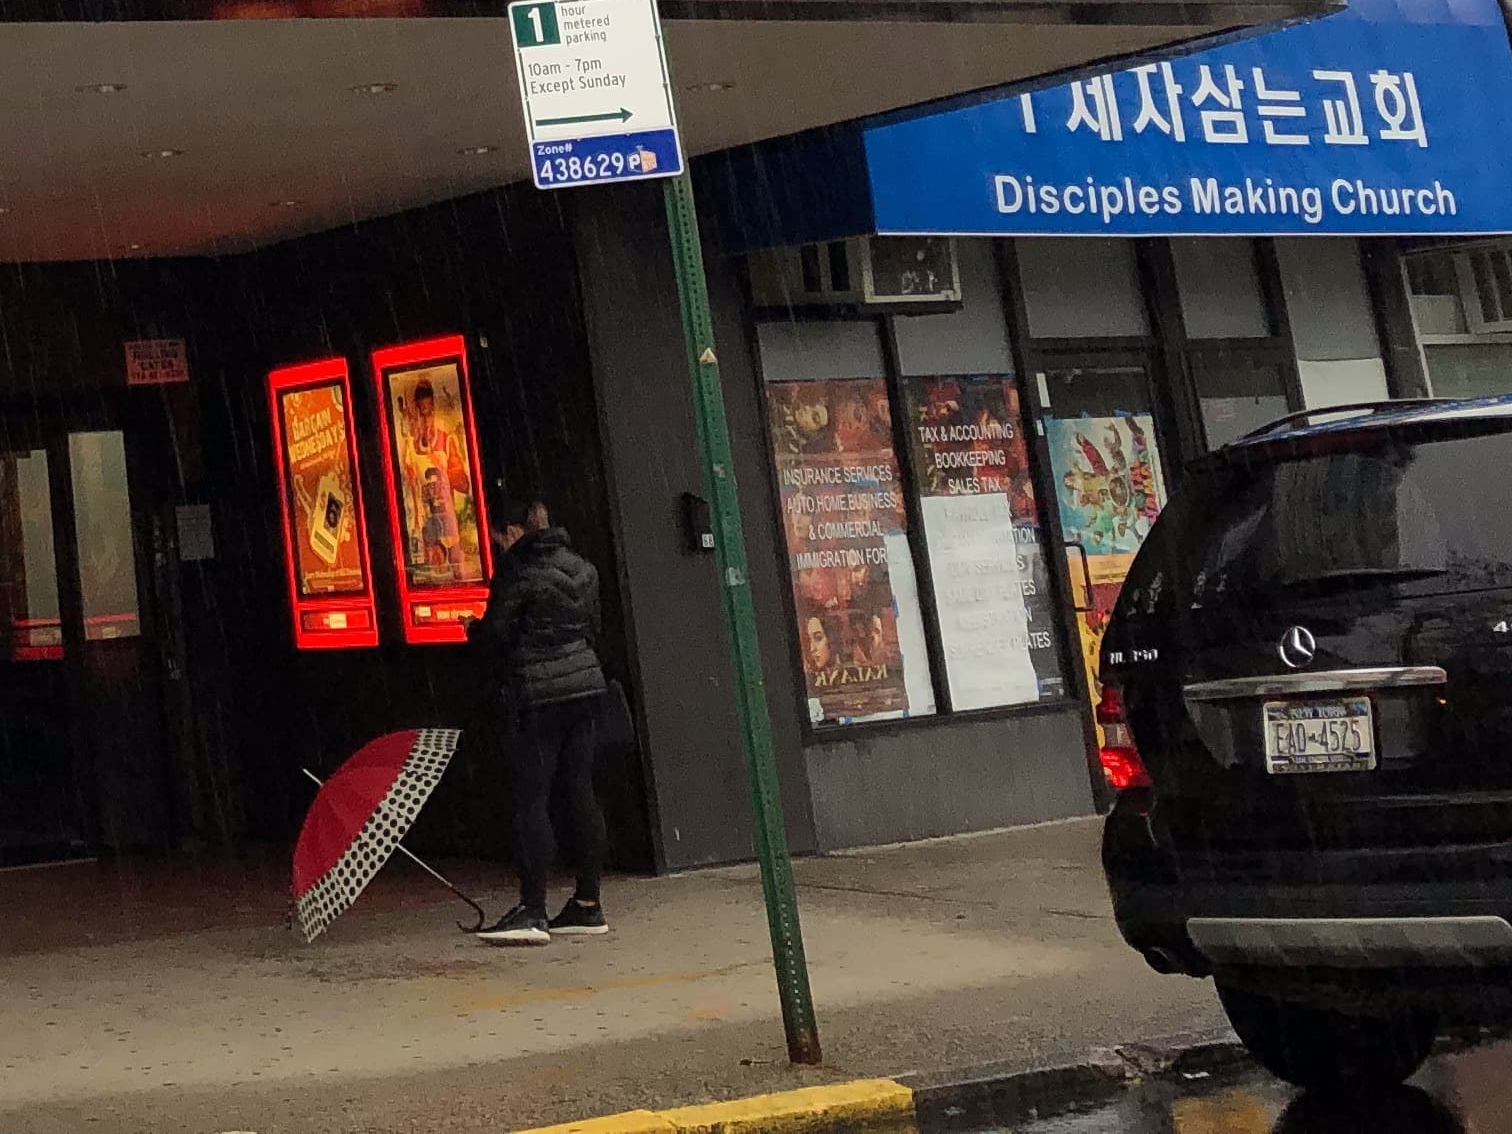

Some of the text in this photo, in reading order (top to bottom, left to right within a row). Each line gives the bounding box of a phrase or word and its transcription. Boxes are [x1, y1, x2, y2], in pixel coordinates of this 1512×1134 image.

[561, 5, 586, 17] hour
[527, 6, 545, 44] 1
[563, 15, 610, 32] metered
[565, 29, 607, 46] parking
[528, 61, 561, 77] 10am
[575, 58, 602, 74] 7pm
[531, 73, 626, 95] Except Sunday
[540, 152, 624, 182] 438629
[995, 175, 1457, 224] Disciples Making Church
[918, 423, 1014, 443] TAX & ACCOUNTING
[935, 450, 1006, 468] BOOKKEEPING
[783, 465, 893, 485] INSURANCE SERVICES
[948, 476, 1002, 494] SALES TAX
[809, 520, 885, 540] & COMMERCIAL
[796, 547, 888, 570] IMMIGRATION FOR
[1319, 719, 1362, 753] 4525
